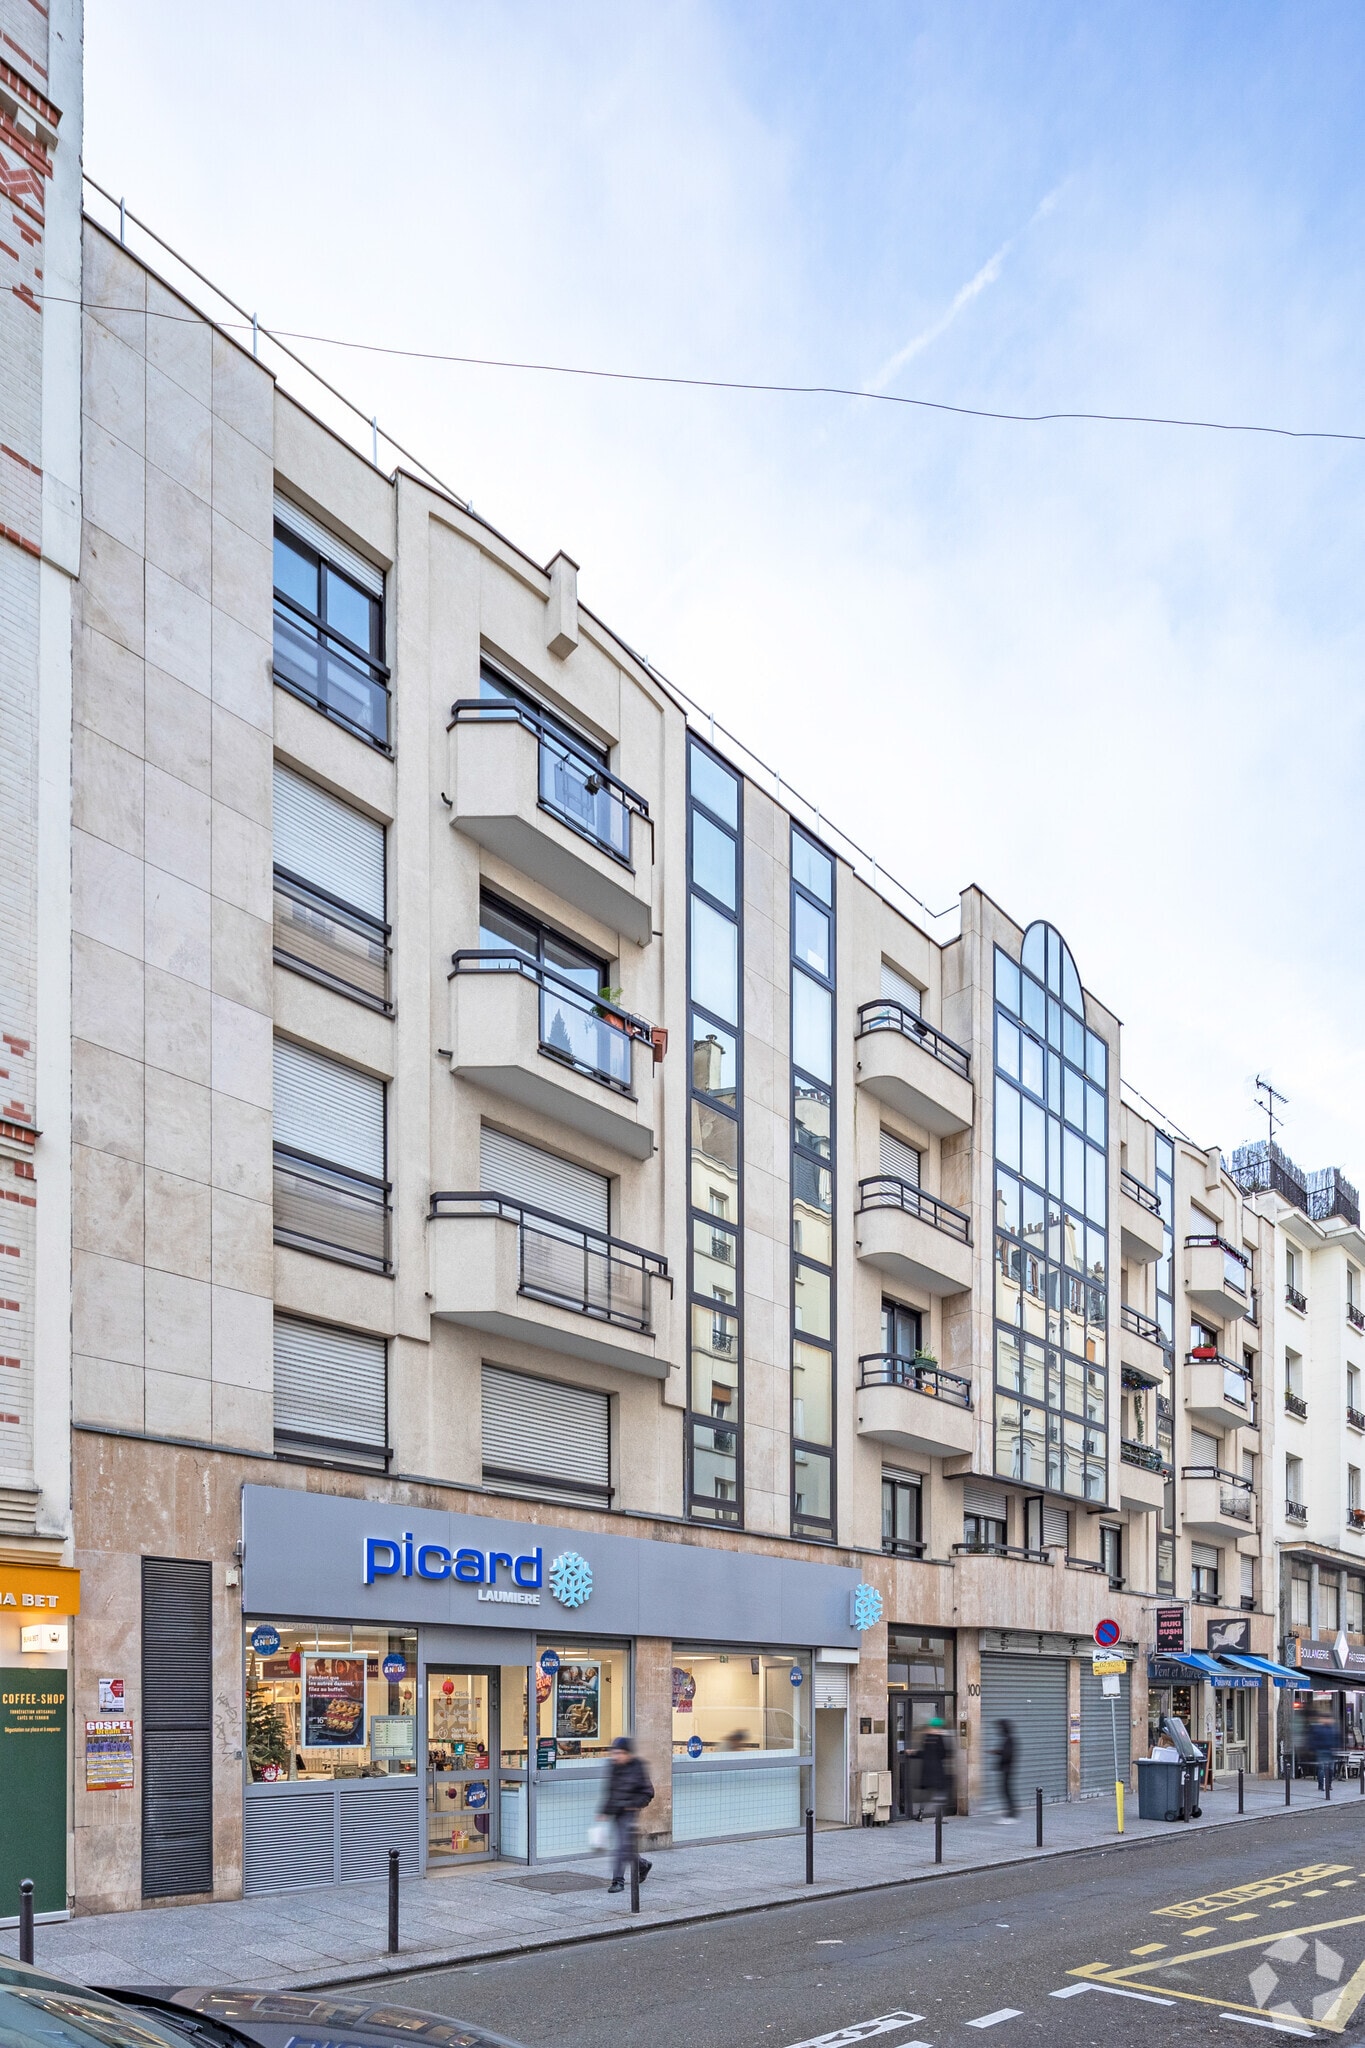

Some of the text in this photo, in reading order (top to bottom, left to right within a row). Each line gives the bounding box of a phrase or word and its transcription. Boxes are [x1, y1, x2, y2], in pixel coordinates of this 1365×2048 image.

[363, 1532, 543, 1588] picard
[22, 1593, 60, 1608] BET
[478, 1589, 541, 1606] LAUMIERE
[1160, 1620, 1182, 1628] MUKI
[1300, 1647, 1330, 1660] BOULANGERIE
[1154, 1664, 1170, 1678] Vent
[1171, 1667, 1179, 1677] et
[968, 1683, 981, 1697] 100
[2, 1693, 65, 1705] COFFEE-SHOP
[86, 1721, 132, 1731] GOSPEL
